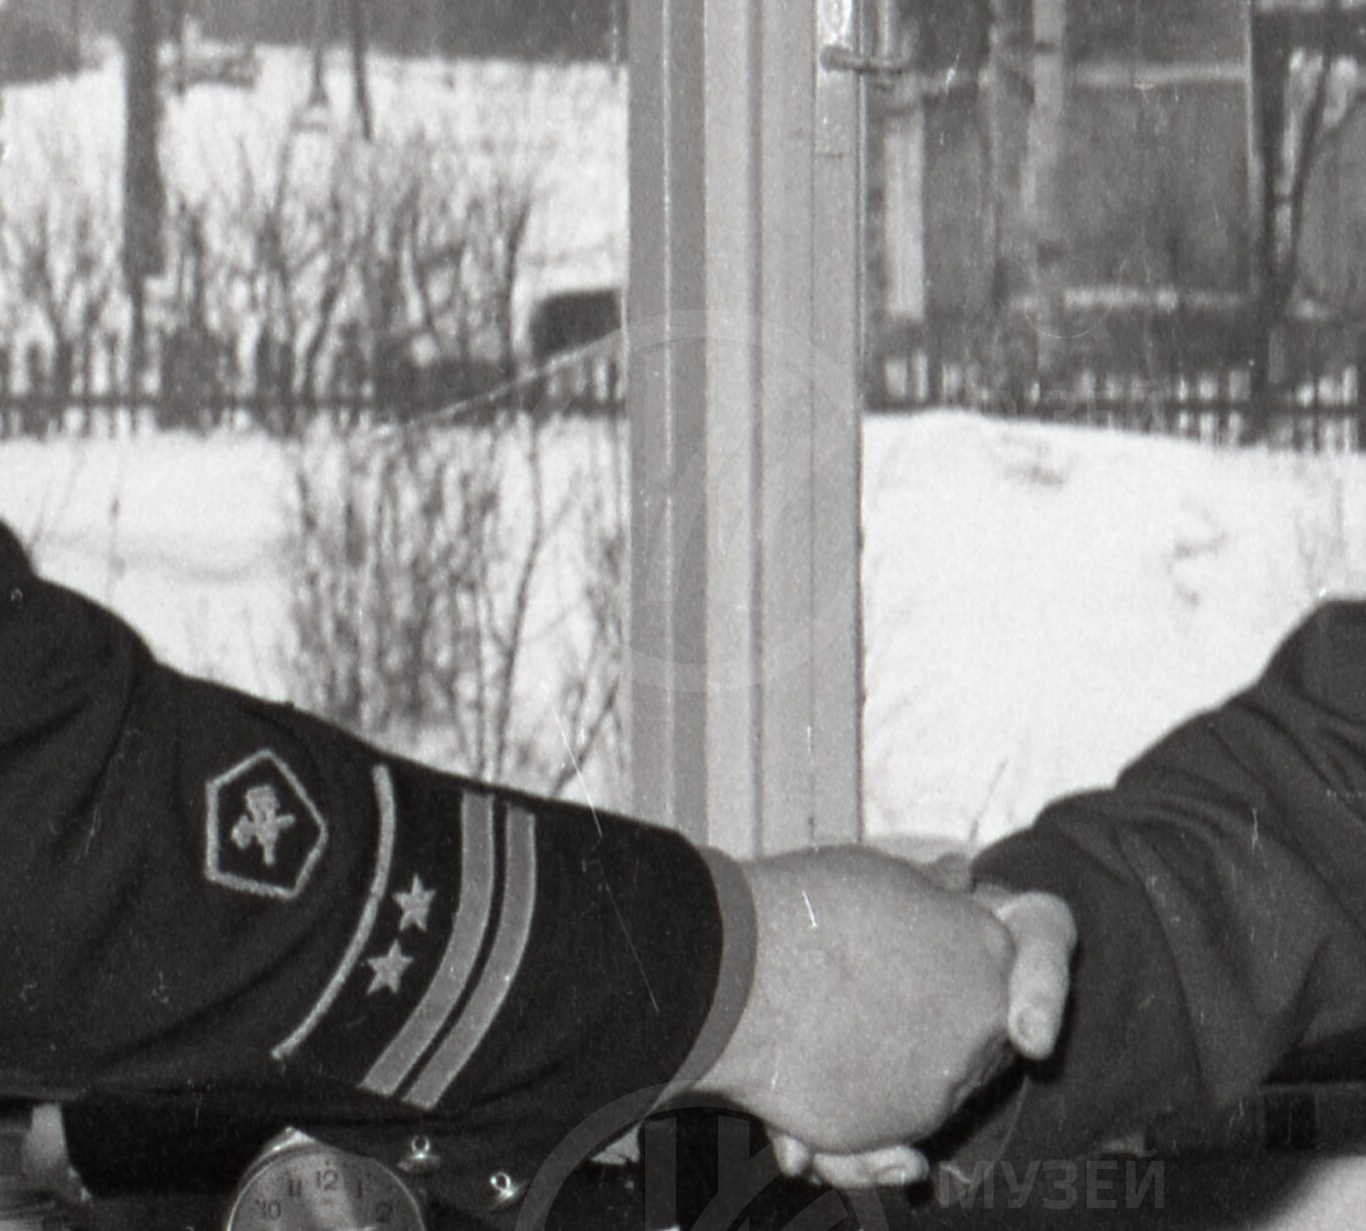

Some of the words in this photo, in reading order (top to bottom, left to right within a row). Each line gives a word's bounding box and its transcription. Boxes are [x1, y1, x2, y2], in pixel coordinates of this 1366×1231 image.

[287, 1178, 303, 1198] 11
[316, 1170, 339, 1191] 12
[255, 1199, 283, 1220] 10
